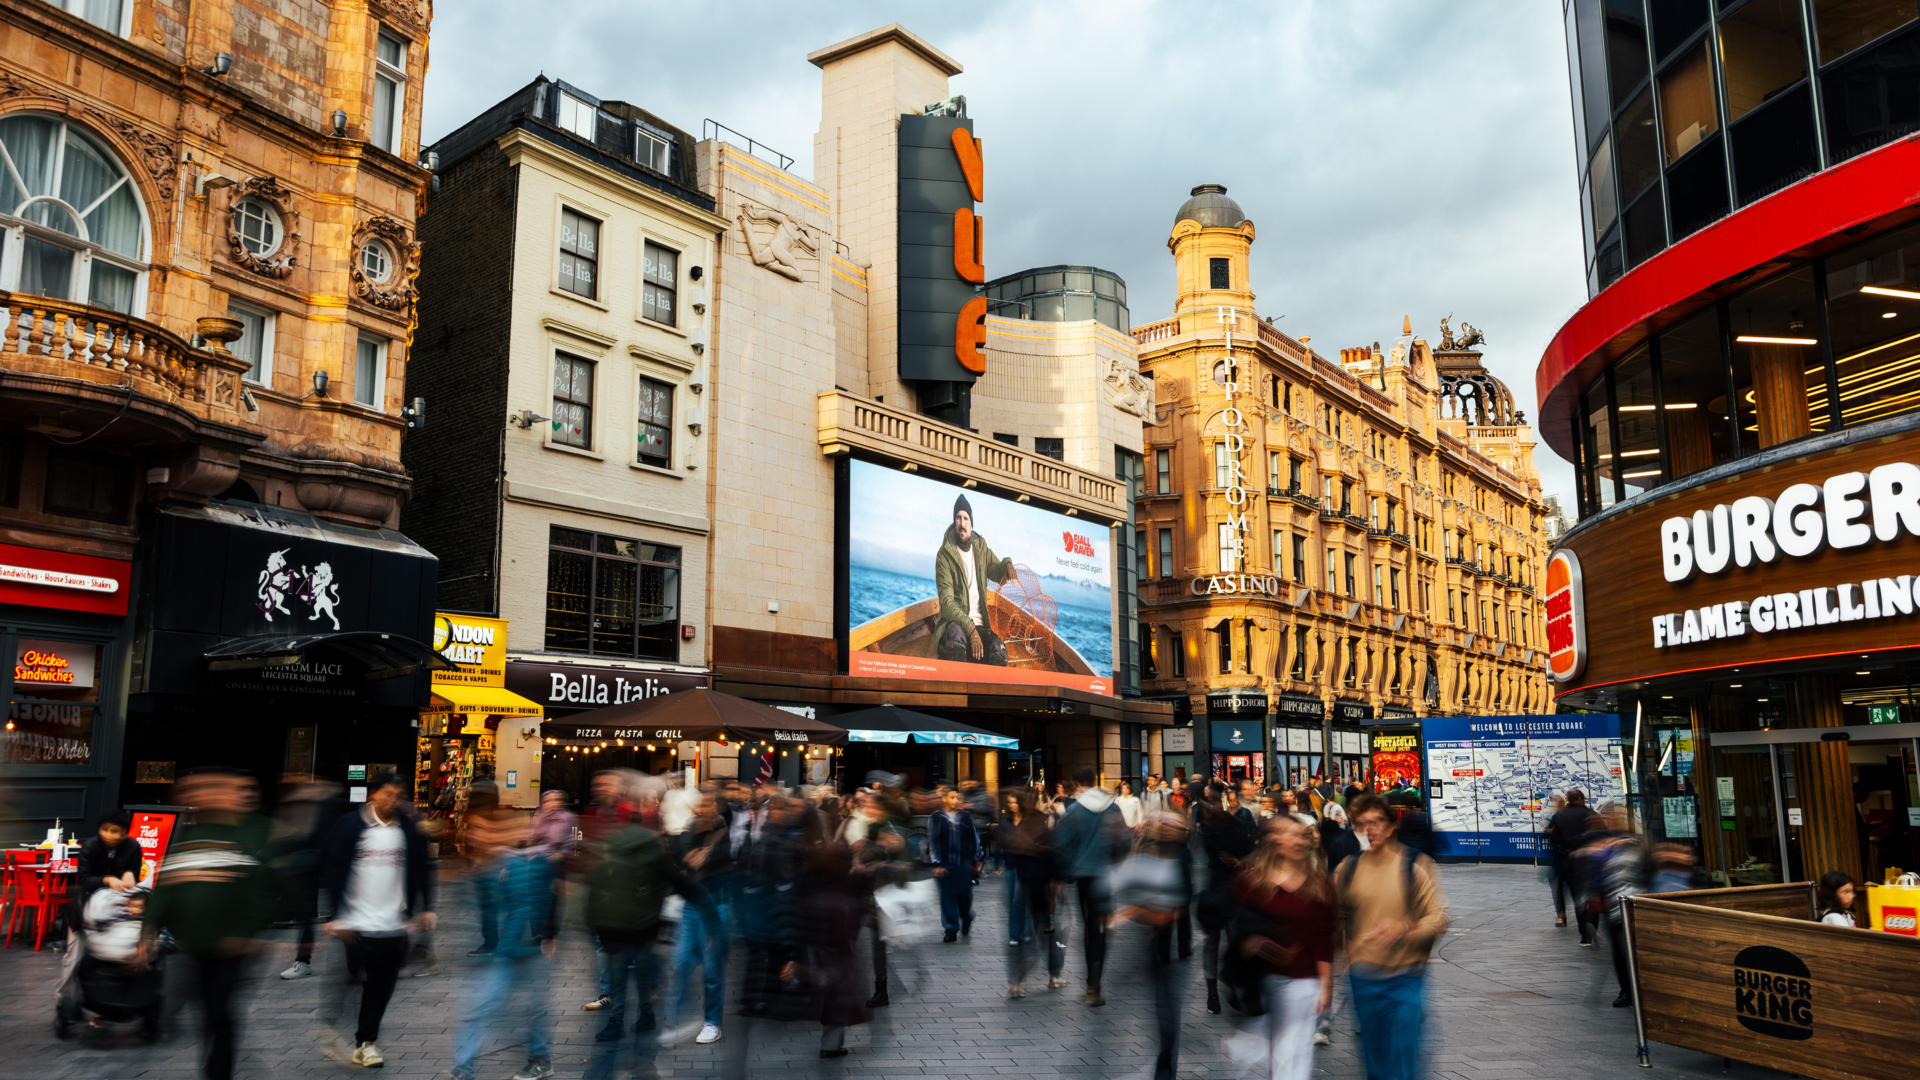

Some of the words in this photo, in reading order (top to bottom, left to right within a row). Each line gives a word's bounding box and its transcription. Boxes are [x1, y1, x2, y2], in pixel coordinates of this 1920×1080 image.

[560, 224, 595, 253] Bella
[643, 256, 674, 283] Bella
[555, 356, 586, 380] Pizza
[554, 376, 583, 397] Pasta
[555, 403, 583, 421] Grill
[1217, 306, 1250, 559] HIPPODROME
[1661, 462, 1920, 583] BURGER
[1056, 556, 1070, 567] Never
[1071, 559, 1079, 569] feel
[1080, 561, 1090, 571] cold
[1090, 564, 1103, 575] again
[44, 572, 63, 584] House
[64, 575, 86, 587] Sauces
[91, 578, 112, 590] Shakes
[1191, 573, 1279, 597] CASINO
[1547, 613, 1574, 655] KING
[1652, 601, 1746, 649] FLAME
[451, 623, 495, 646] NDON
[23, 650, 70, 668] Chicken
[14, 665, 74, 684] Sandwiches
[261, 670, 298, 681] LEICESTER
[300, 674, 326, 683] SQUARE
[315, 663, 343, 676] LACE
[434, 673, 463, 682] TOBACCO
[464, 674, 468, 682] &
[480, 668, 502, 676] DRINKS
[226, 681, 264, 691] COCKTAIL
[266, 684, 280, 692] BAR
[289, 686, 337, 695] GENTLEMEN'S
[338, 689, 356, 697] CLUB
[548, 672, 609, 705] Bella
[459, 705, 476, 713] GIFTS
[480, 706, 514, 714] SOUVENIRS
[518, 707, 539, 715] DRINKS
[1212, 698, 1267, 708] HIPPODROME
[1280, 700, 1322, 715] HIPPODROME
[1343, 706, 1364, 719] CASINO
[576, 728, 602, 738] PIZZA
[614, 729, 643, 738] PASTA
[655, 729, 683, 739] GRILL
[1504, 723, 1513, 731] TO
[1515, 722, 1554, 731] LEICESTER
[1556, 721, 1583, 730] SQUARE
[480, 738, 491, 748] £1
[774, 730, 791, 741] Bella
[791, 731, 809, 742] Italia
[1373, 738, 1417, 748] SPECTACULAR
[43, 742, 57, 760] to
[57, 740, 90, 760] order
[139, 825, 159, 837] Fresh
[1885, 916, 1916, 930] LEGO
[1734, 968, 1812, 1000] BURGER
[1735, 987, 1813, 1027] KING
